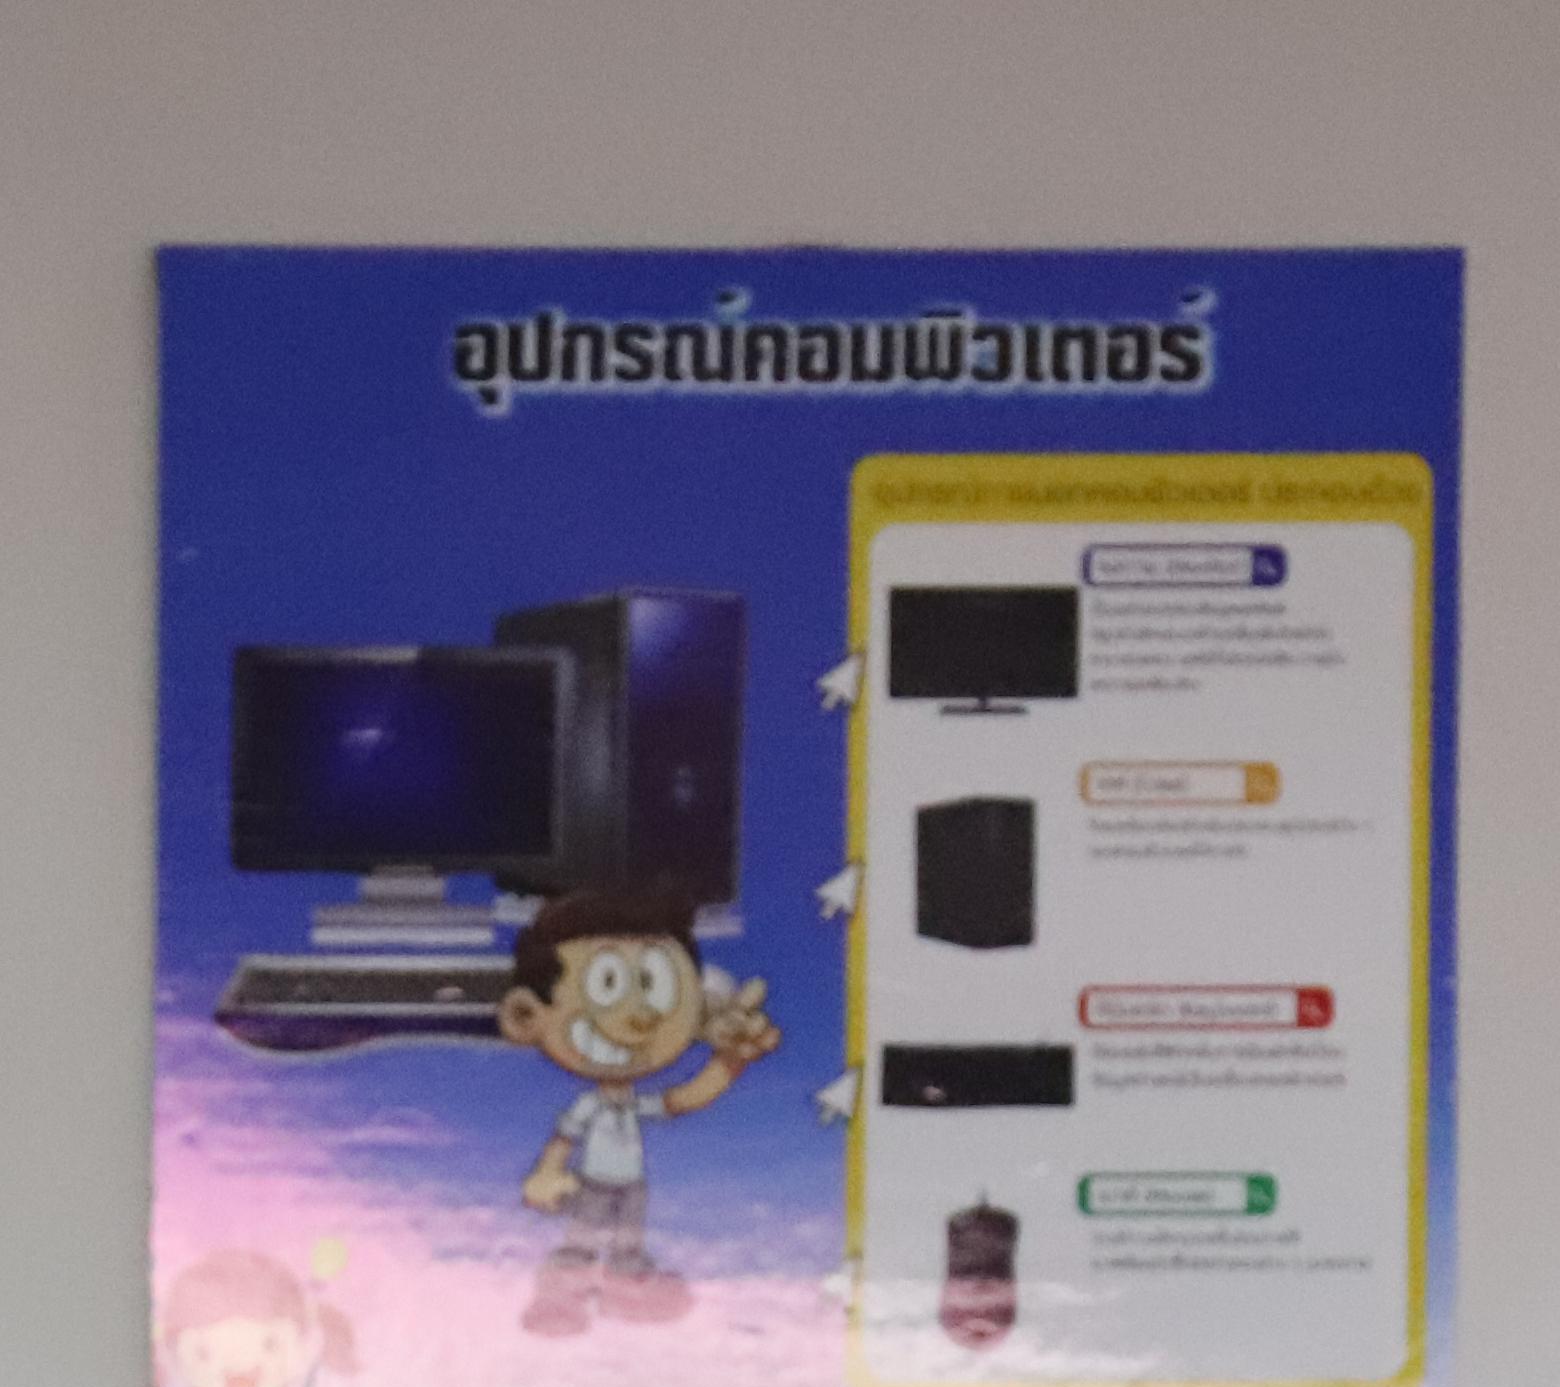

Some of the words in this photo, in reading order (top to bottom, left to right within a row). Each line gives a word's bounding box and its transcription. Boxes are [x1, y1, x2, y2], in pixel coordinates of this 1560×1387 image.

[452, 288, 1216, 413] อุปกรณ์คอมพิวเตอร์
